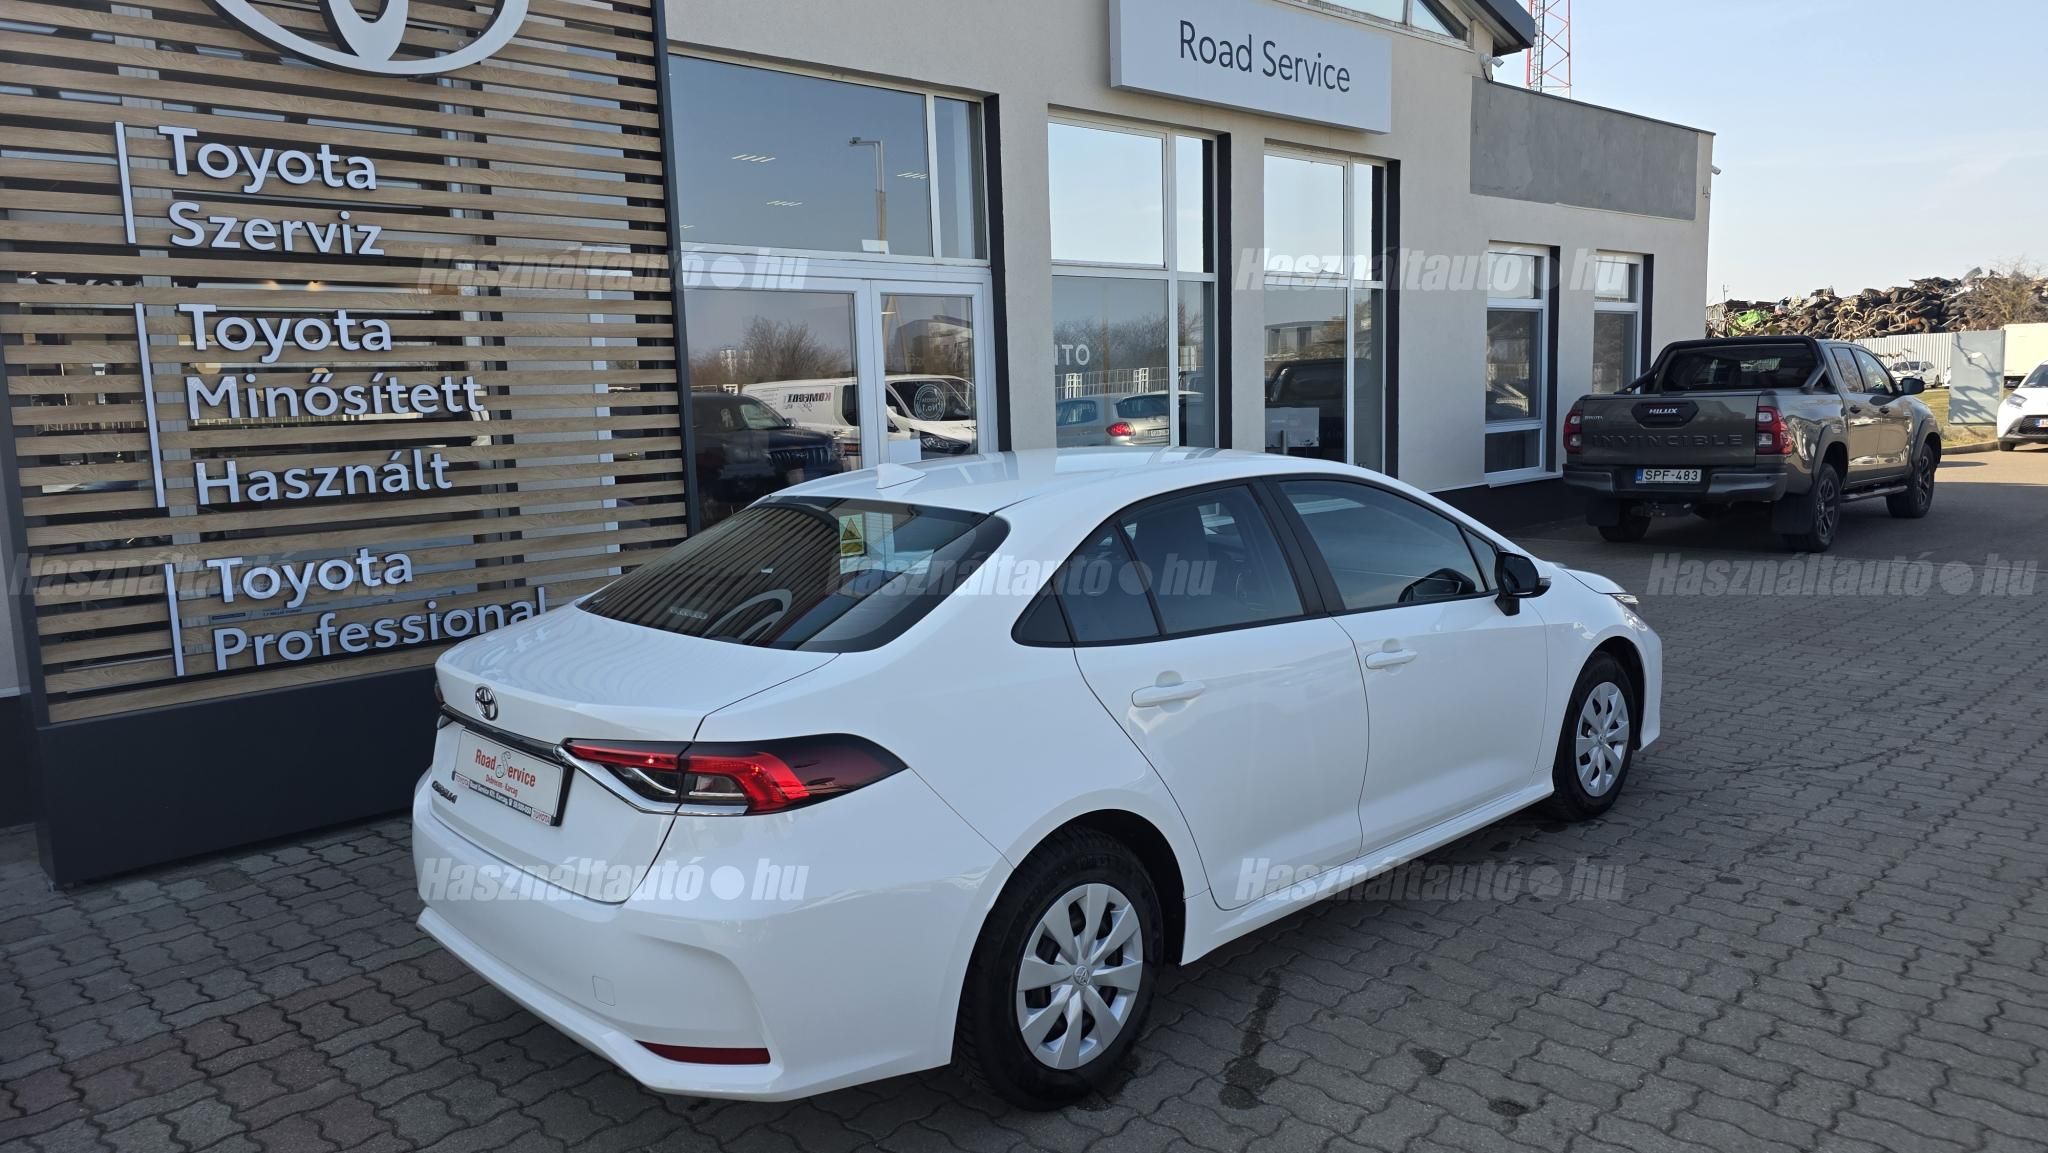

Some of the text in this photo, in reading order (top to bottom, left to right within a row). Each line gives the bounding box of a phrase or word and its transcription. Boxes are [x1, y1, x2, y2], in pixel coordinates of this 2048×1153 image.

[1180, 20, 1351, 93] Road Service
[157, 124, 378, 195] Toyota
[167, 200, 385, 257] Szerviz
[177, 302, 393, 364] Toyota
[186, 371, 486, 421] Minősített
[1648, 407, 1679, 415] HILUX
[1592, 434, 1744, 448] INVINCIBLE
[195, 449, 454, 508] Használt
[1644, 470, 1699, 481] SPF-483
[207, 547, 414, 608] Toyota
[211, 586, 547, 673] Professional
[475, 749, 497, 770] Road
